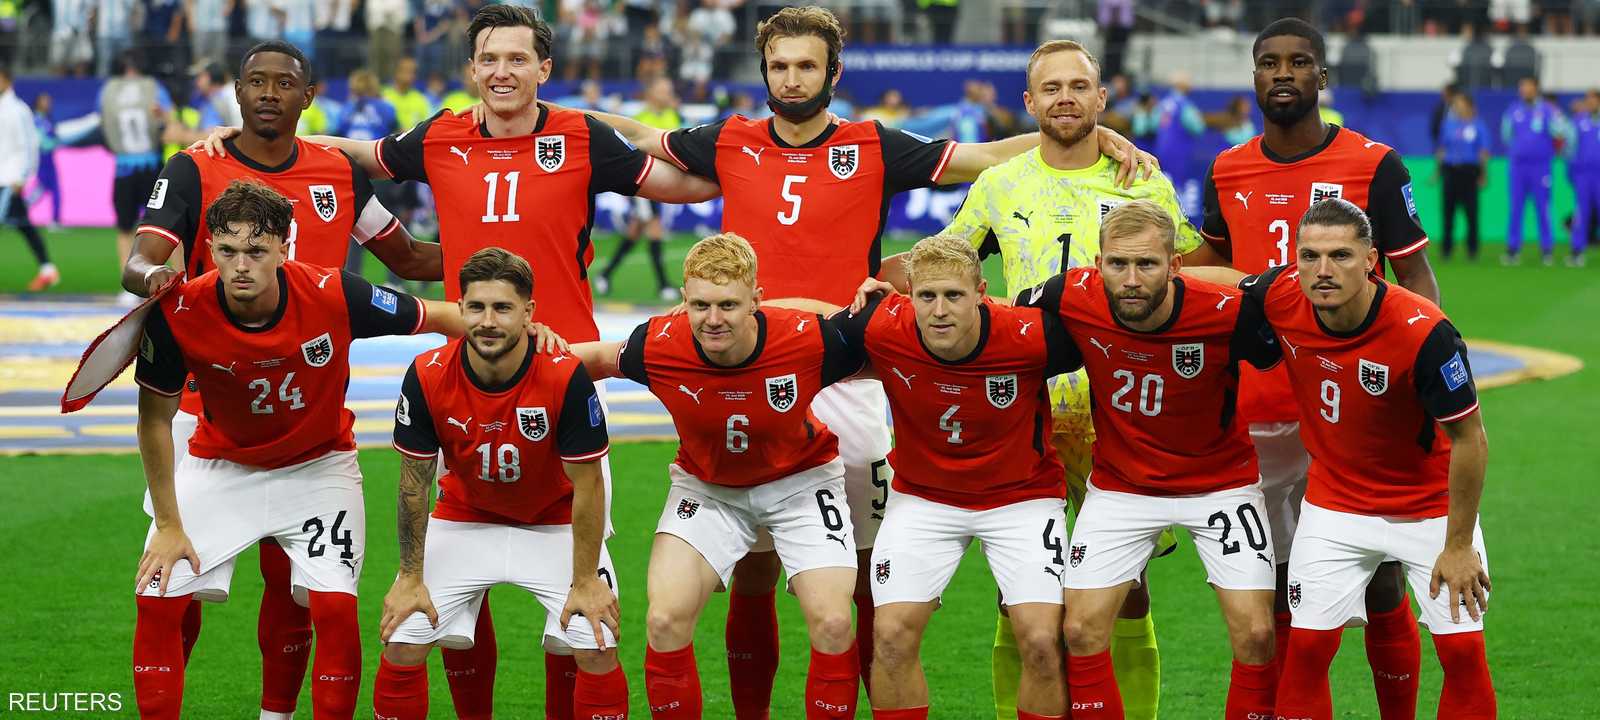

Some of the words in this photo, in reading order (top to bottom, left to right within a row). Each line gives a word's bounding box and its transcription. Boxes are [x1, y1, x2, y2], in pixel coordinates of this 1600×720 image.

[481, 171, 521, 223] 11
[777, 174, 809, 225] 5
[1057, 233, 1073, 271] 1
[1268, 219, 1289, 268] 3
[248, 371, 305, 414] 24
[1111, 368, 1165, 416] 20
[1320, 379, 1341, 424] 9
[726, 414, 749, 453] 6
[939, 404, 963, 444] 4
[475, 442, 521, 483] 18
[871, 458, 888, 511] 5
[815, 489, 844, 531] 6
[1207, 502, 1267, 555] 20
[302, 510, 354, 559] 24
[1042, 518, 1065, 566] 4
[1072, 701, 1103, 710] ÖFB
